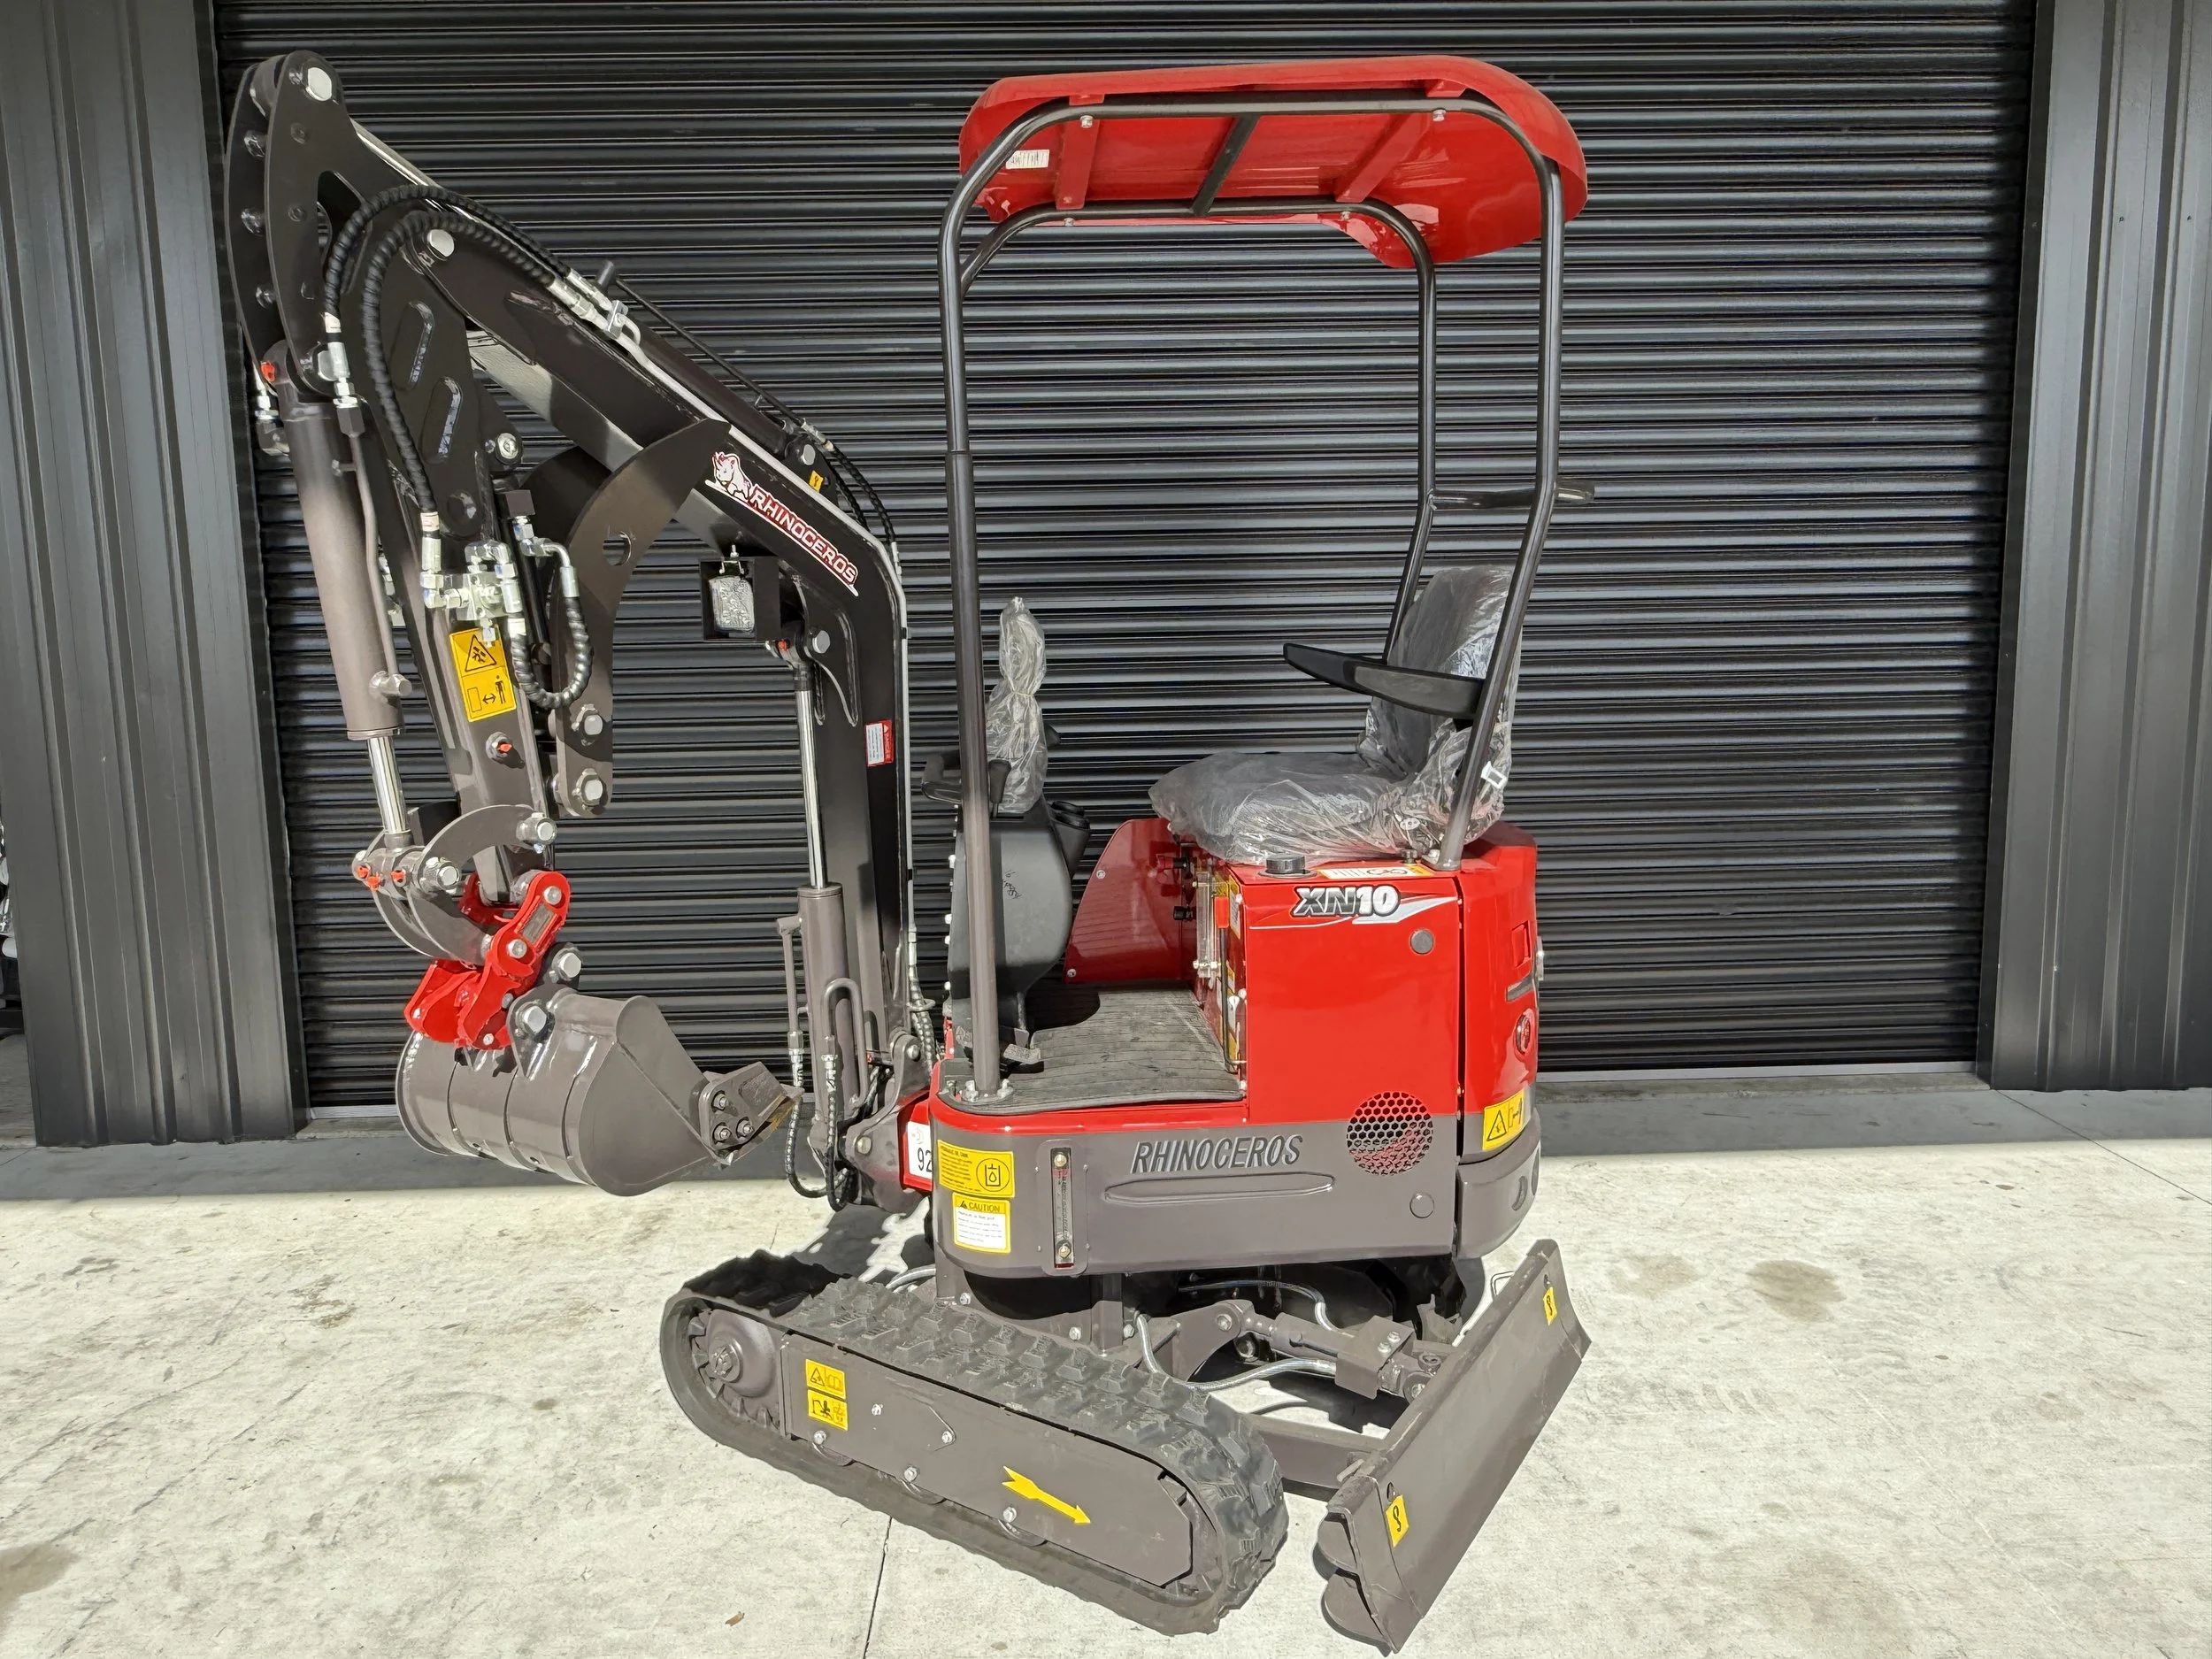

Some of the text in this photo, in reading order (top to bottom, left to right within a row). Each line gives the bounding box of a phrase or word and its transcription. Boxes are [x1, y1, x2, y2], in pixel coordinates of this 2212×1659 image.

[750, 487, 858, 584] RHINOCEROS
[1290, 884, 1401, 917] XN10
[1130, 1134, 1303, 1174] RHINOCEROS
[968, 1202, 1001, 1213] CAUTION
